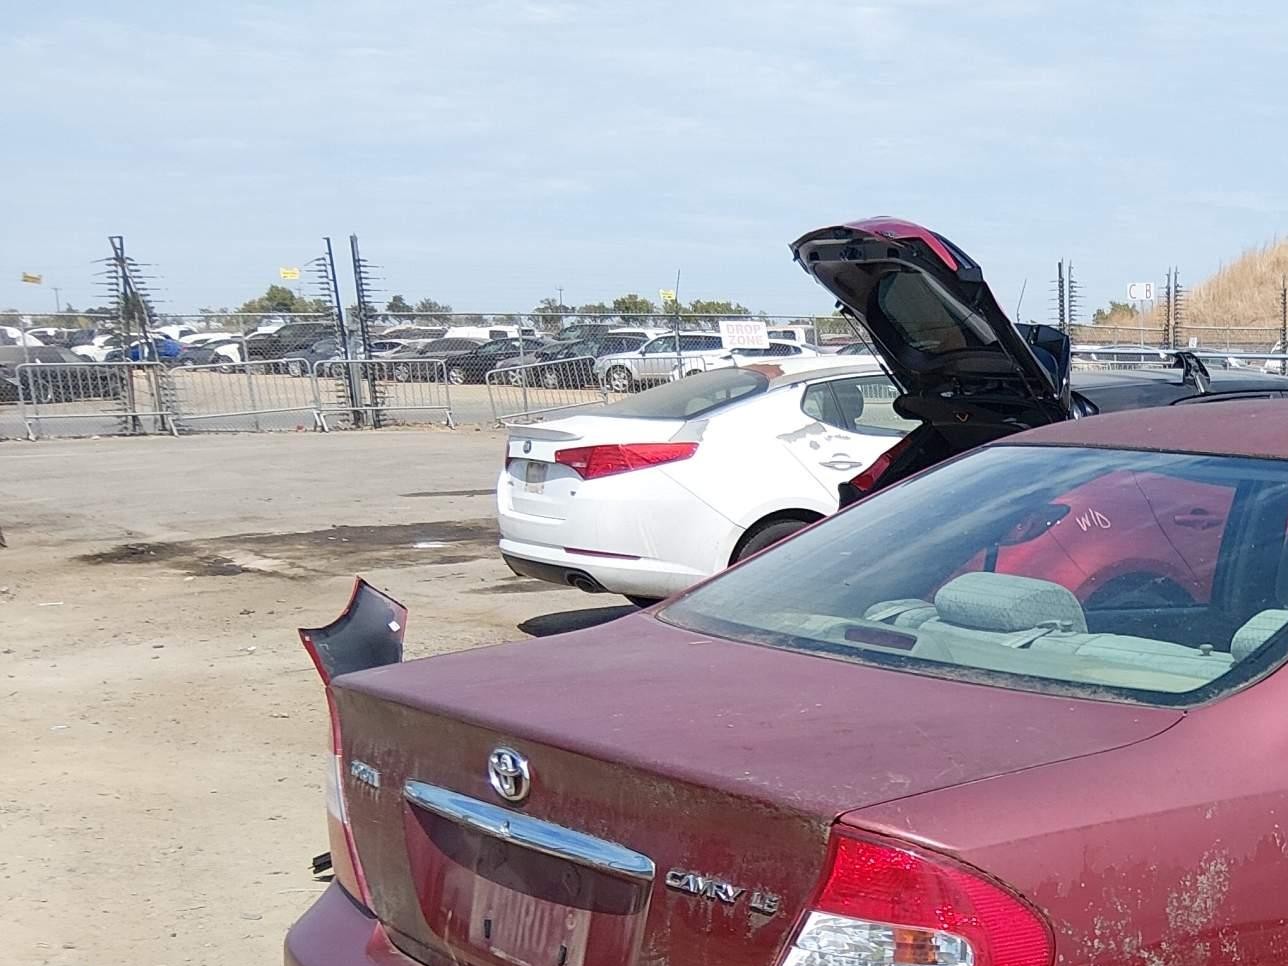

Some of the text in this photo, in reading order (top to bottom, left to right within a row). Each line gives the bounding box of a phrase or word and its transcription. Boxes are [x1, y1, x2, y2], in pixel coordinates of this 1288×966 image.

[1129, 283, 1152, 299] C B
[726, 324, 761, 335] DROP
[728, 335, 765, 346] ZONE
[665, 870, 780, 912] CAMRY LE
